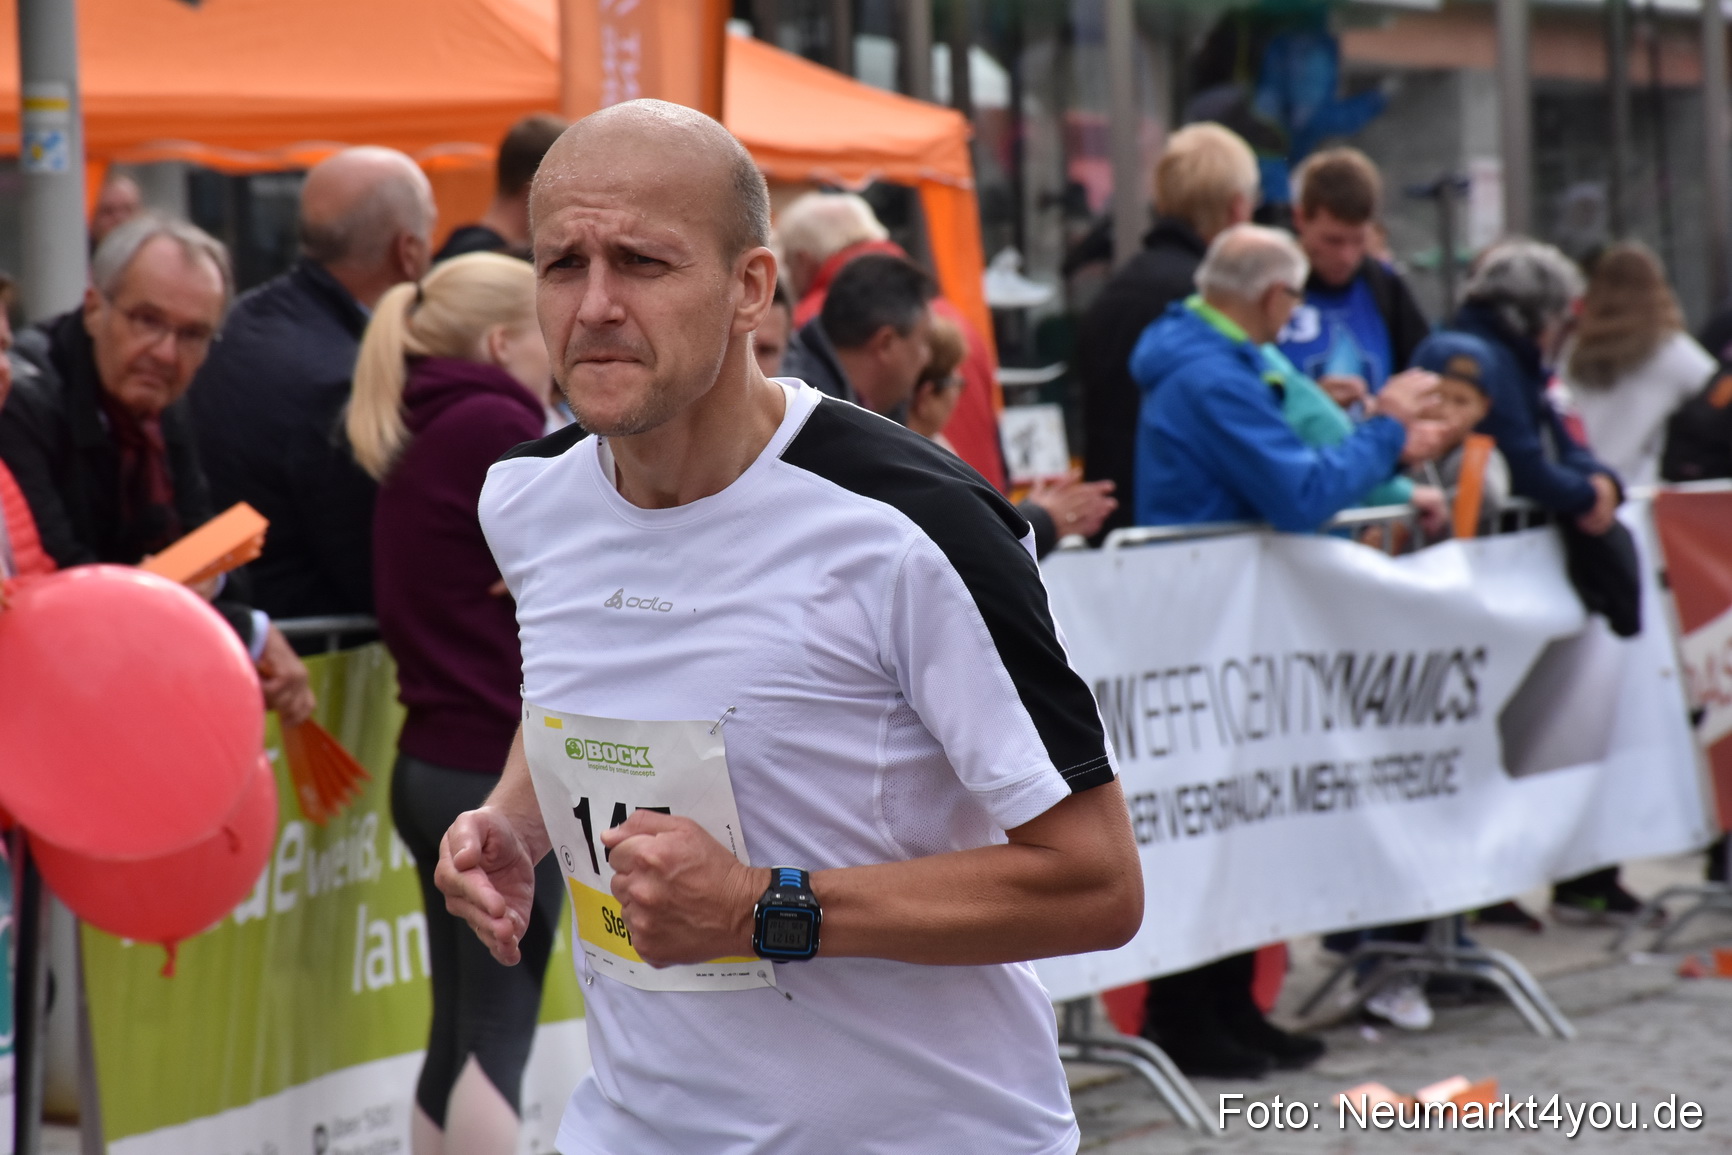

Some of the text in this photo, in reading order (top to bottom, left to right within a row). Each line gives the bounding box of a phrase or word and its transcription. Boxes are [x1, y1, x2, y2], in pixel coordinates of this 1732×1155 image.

[626, 597, 673, 612] odlo
[585, 739, 653, 769] BOCK
[588, 762, 608, 771] inspired
[609, 765, 615, 773] by
[353, 904, 432, 994] lan
